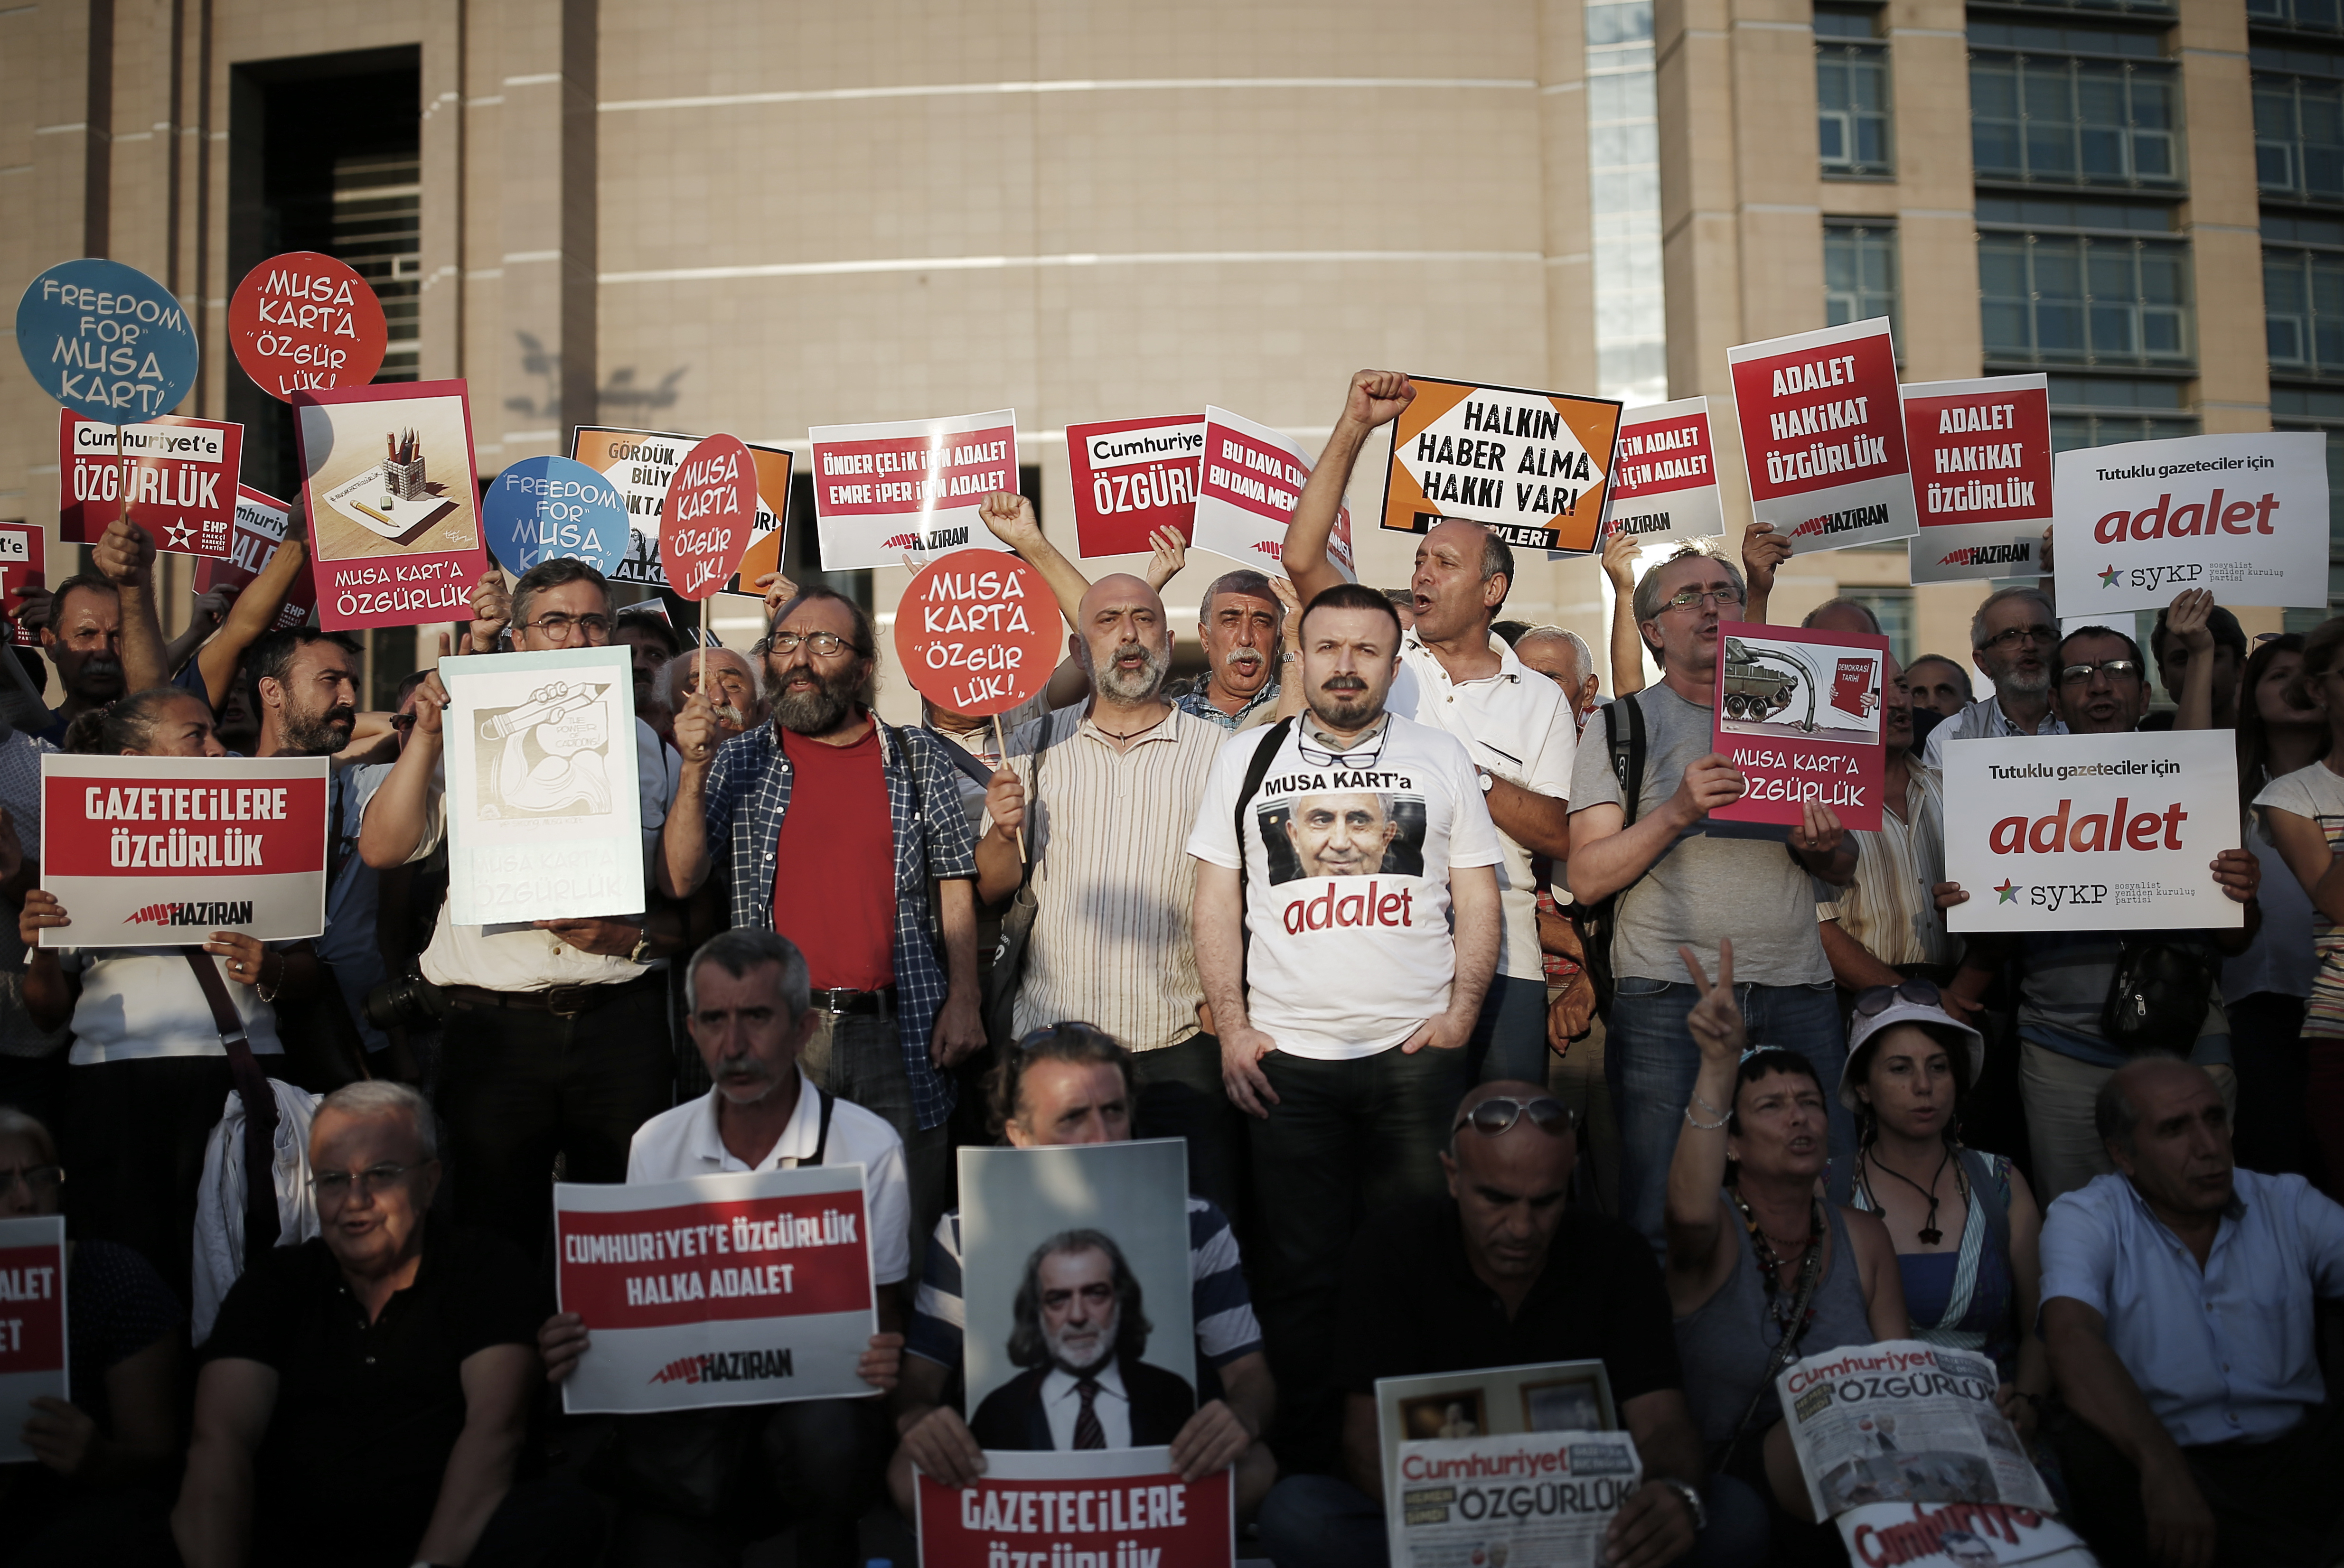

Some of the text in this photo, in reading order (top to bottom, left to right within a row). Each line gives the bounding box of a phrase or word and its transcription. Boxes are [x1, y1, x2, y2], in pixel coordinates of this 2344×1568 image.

[43, 280, 182, 331] FREEDOM
[265, 270, 355, 306] MUSA
[80, 316, 138, 345] FOR
[259, 298, 356, 339] KART'A
[52, 336, 164, 381] MUSA
[257, 330, 347, 370] ÖZGÜR
[61, 370, 167, 416] KART!
[279, 370, 337, 395] LÜK!
[1772, 355, 1856, 398] ADALET
[1463, 401, 1560, 441] HALKIN
[1770, 396, 1869, 441] HAKİKAT
[1939, 404, 2015, 434] ADALET
[609, 440, 679, 467] GÖRDÜK,
[1093, 432, 1203, 460] Cumhuriye
[1417, 433, 1507, 472] HABER
[1517, 447, 1590, 482] ALMA
[1646, 427, 1699, 454] ADALET
[631, 465, 671, 487] BİLİY
[682, 454, 739, 492] MUSA
[822, 452, 873, 476] ÖNDER
[876, 451, 918, 478] ÇELİK
[954, 440, 1007, 466] ADALET
[1222, 439, 1244, 464] BU
[1244, 448, 1283, 480] DAVA
[1622, 463, 1653, 490] İÇİN
[1655, 455, 1707, 481] ADALET
[1766, 433, 1888, 485] ÖZGÜRLÜK
[1934, 443, 2024, 474] HAKİKAT
[2096, 456, 2275, 481] Tutuklu gazeteciler için
[74, 457, 221, 510] ÖZGÜRLÜK
[506, 474, 618, 509] FREEDOM
[829, 485, 873, 505] EMRE
[875, 482, 913, 503] İPER
[950, 469, 1006, 497] ADALET
[1093, 459, 1201, 515] ÖZGÜRL
[1209, 464, 1228, 489] BU
[1230, 473, 1266, 504] DAVA
[1422, 470, 1578, 517] HAKKI VAR!
[1927, 476, 2036, 513] ÖZGÜRLÜK
[536, 500, 581, 523] FOR
[676, 484, 738, 522] KART'A
[1823, 503, 1889, 535] HAZİRAN
[2094, 488, 2281, 544] adalet
[203, 520, 228, 533] EHP
[512, 516, 602, 553] MUSA
[1615, 512, 1671, 535] HAZİRAN
[675, 528, 731, 557] ÖZGÜR
[1969, 543, 2031, 565] HAZİRAN
[334, 560, 463, 588] MUSA KART'A
[686, 556, 724, 594] LÜK!
[928, 569, 1025, 602] MUSA
[2247, 569, 2284, 577] kuruluş
[283, 603, 306, 618] EHP
[336, 584, 472, 616] ÖZGÜRLÜK
[924, 602, 1030, 634] KART'A
[926, 641, 1023, 672] ÖZGÜR
[1837, 663, 1870, 673] DEMOKRASİ
[952, 673, 1014, 708] LÜK!
[1842, 673, 1860, 683] TARİHİ
[1732, 748, 1859, 775] MUSA KART'A
[1988, 759, 2181, 781] Tutuklu gazeteciler için
[1265, 771, 1412, 797] MUSA KART'a
[85, 786, 287, 820] GAZETECİLERE
[1989, 797, 2189, 855] adalet
[111, 827, 263, 867] ÖZGÜRLÜK
[475, 854, 533, 874] MUSA
[473, 873, 623, 908] ÖZGÜRLÜK
[2115, 882, 2161, 890] sosyalist
[2115, 888, 2196, 898] yeniden kuruluş
[2115, 896, 2152, 905] partisi
[170, 900, 253, 926] HAZİRAN
[1284, 881, 1414, 935] adalet
[565, 1208, 859, 1265] CUMHURİYET'E ÖZGÜRLÜK
[625, 1263, 795, 1307] HALKA ADALET
[701, 1348, 794, 1383] HAZİRAN
[1788, 1350, 1937, 1394] Cumhuriyet
[1402, 1447, 1569, 1483] Cumhuriyet
[961, 1484, 1187, 1533] GAZETECİLERE
[1459, 1478, 1636, 1522] ÖZGÜRLÜK
